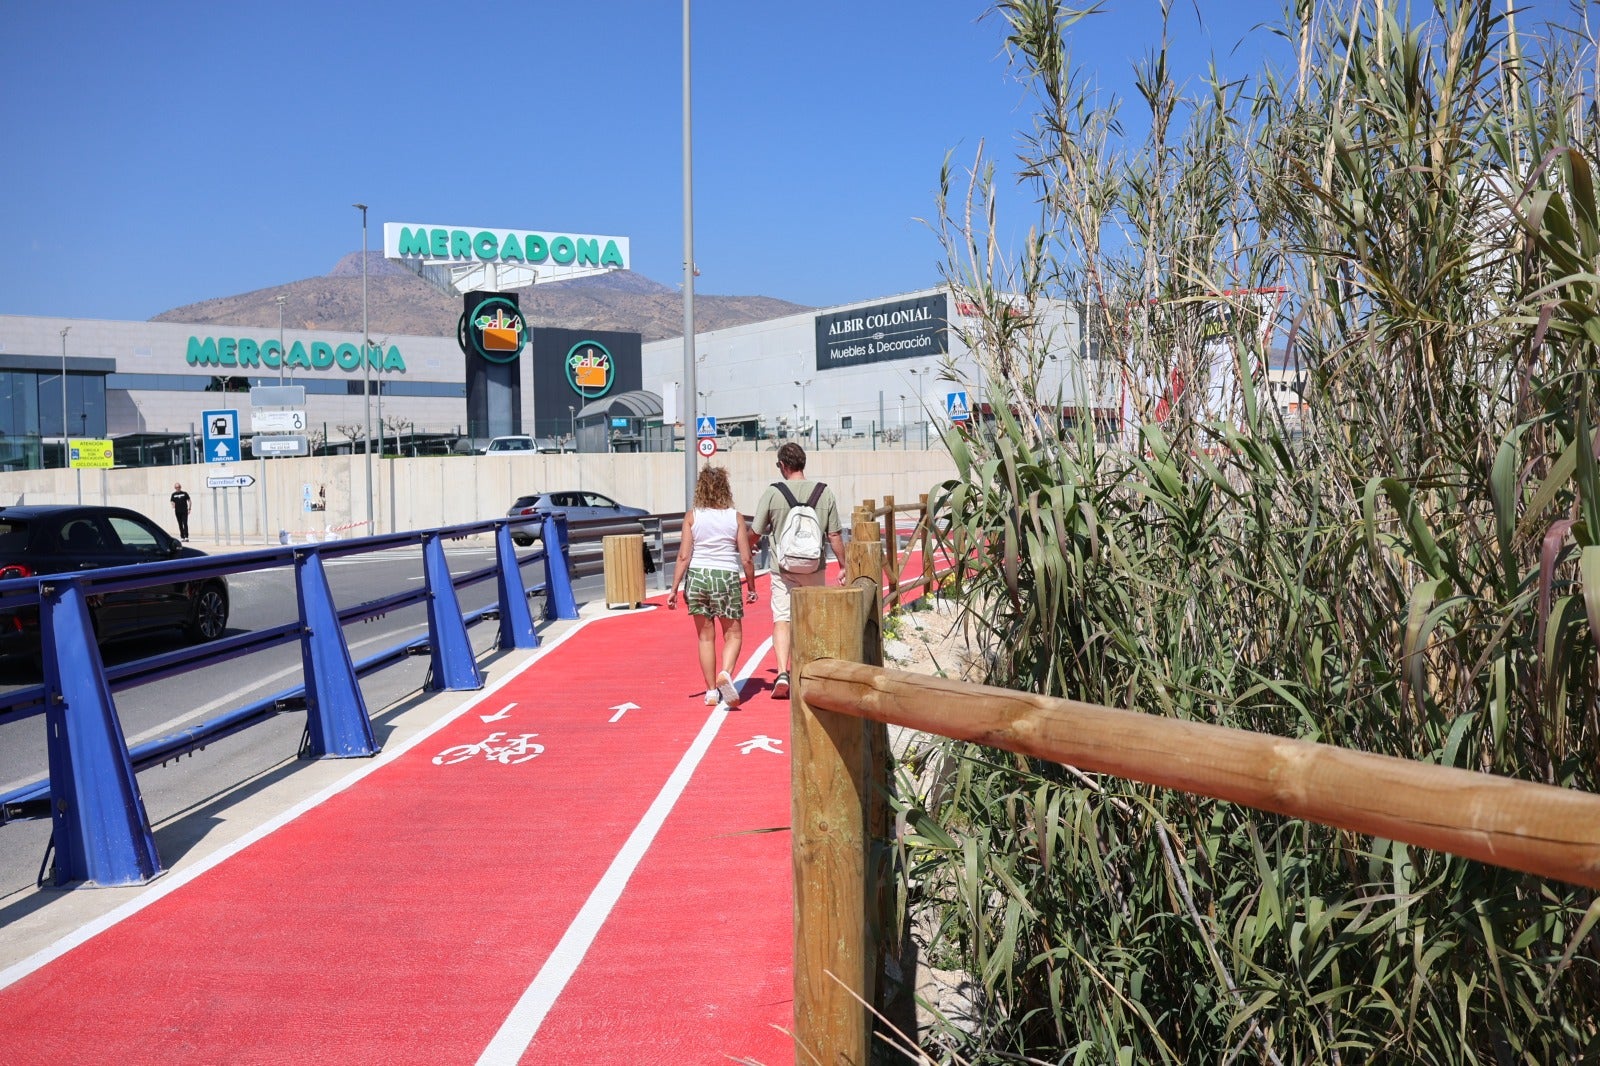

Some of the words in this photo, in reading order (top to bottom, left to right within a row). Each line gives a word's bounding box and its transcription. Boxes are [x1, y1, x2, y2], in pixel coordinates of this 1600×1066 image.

[399, 226, 624, 267] MERCADONA
[828, 317, 865, 336] ALBIR
[866, 306, 932, 329] COLONIAL
[186, 336, 406, 372] MERCADONA
[830, 345, 866, 360] Muebles
[867, 343, 875, 354] &
[876, 334, 931, 353] Decoración
[701, 443, 713, 451] 30
